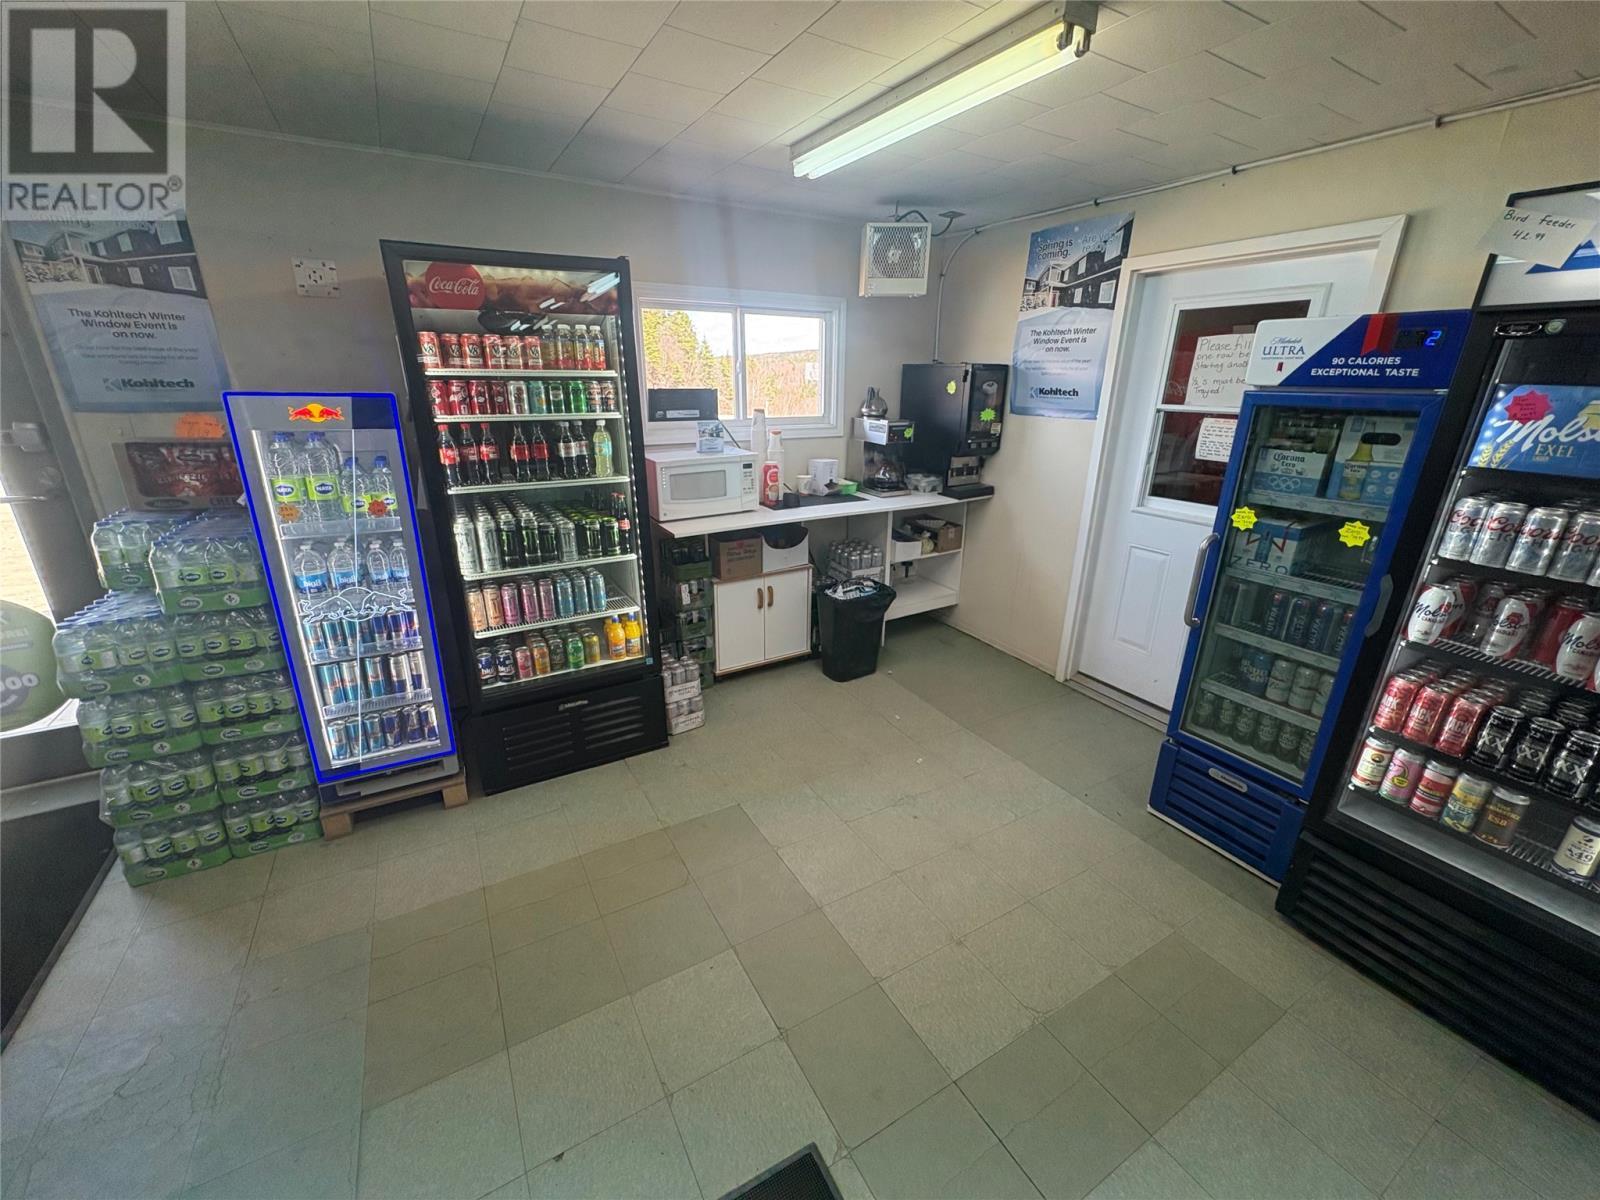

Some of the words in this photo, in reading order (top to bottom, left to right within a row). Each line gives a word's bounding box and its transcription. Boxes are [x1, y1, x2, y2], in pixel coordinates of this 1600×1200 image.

[1503, 209, 1530, 223] Bird
[1038, 240, 1065, 254] Spring
[1065, 239, 1073, 247] is
[1037, 249, 1071, 260] coming.
[68, 308, 91, 318] The
[94, 309, 146, 320] Kohltech
[147, 311, 186, 321] Winter
[81, 319, 130, 329] Window
[134, 321, 167, 330] Event
[168, 322, 178, 330] is
[112, 331, 128, 339] on
[131, 331, 157, 339] now.
[1030, 329, 1042, 337] The
[1043, 327, 1072, 337] Kohltech
[1073, 326, 1097, 335] Winter
[1060, 337, 1079, 345] Event
[1200, 338, 1232, 351] Please
[1233, 335, 1252, 351] fill
[1262, 345, 1306, 356] ULTRA
[1331, 357, 1344, 365] 90
[1347, 356, 1401, 365] CALORIES
[1310, 368, 1380, 377] EXCEPTIONAL
[1385, 368, 1420, 377] TASTE
[121, 378, 196, 390] Kohltech
[1213, 378, 1233, 386] must
[1038, 387, 1079, 397] Kohltech
[1535, 443, 1574, 457] EXEL
[1273, 452, 1305, 463] Corona
[1231, 555, 1288, 575] ZERO
[1266, 607, 1279, 631] ULTRA
